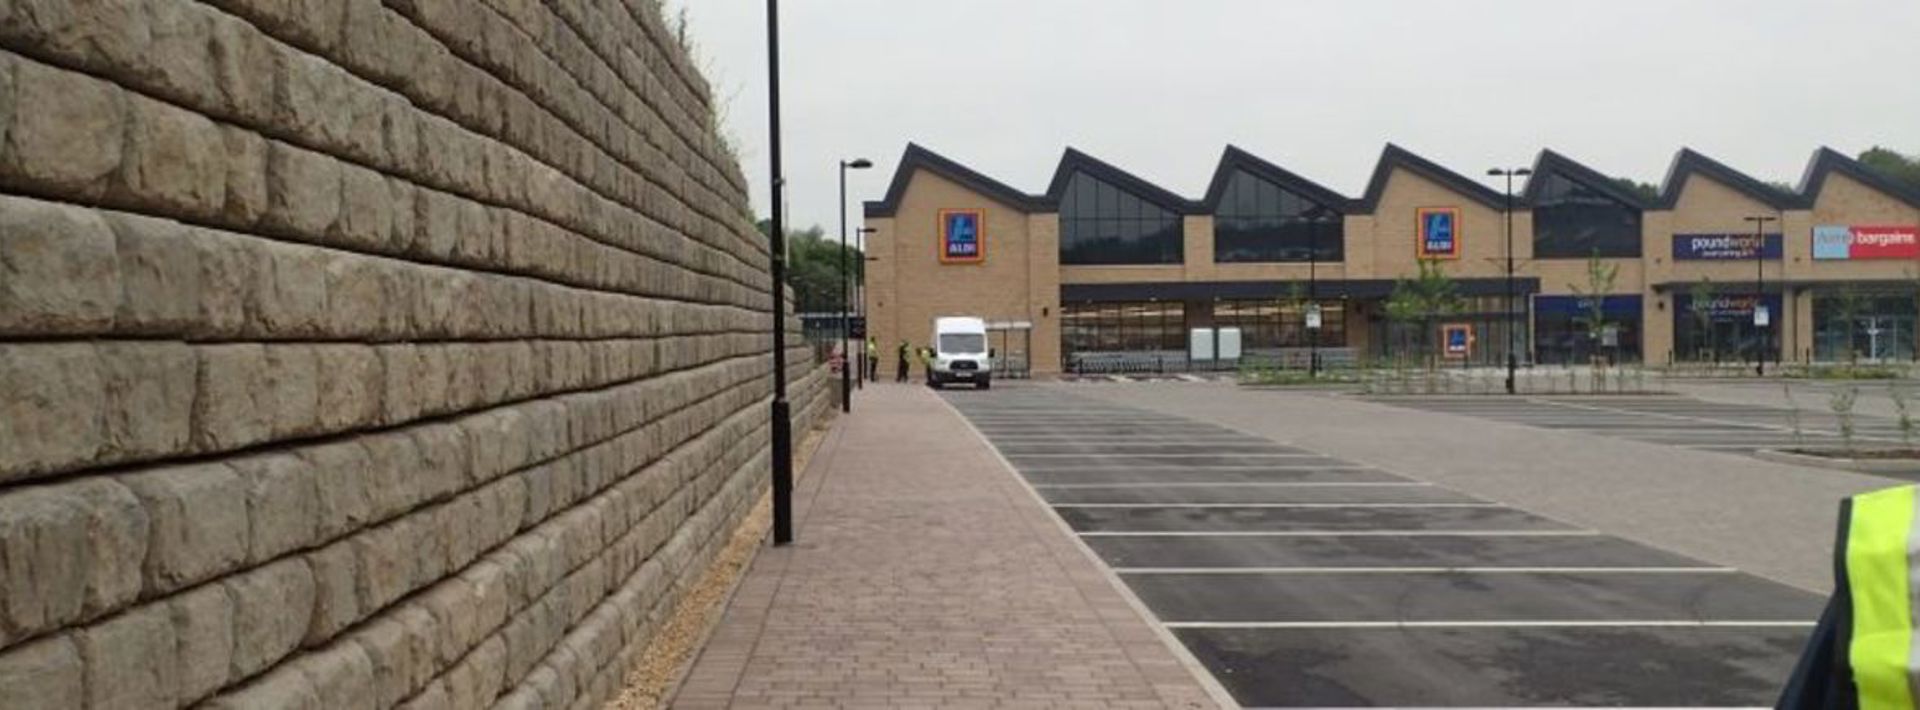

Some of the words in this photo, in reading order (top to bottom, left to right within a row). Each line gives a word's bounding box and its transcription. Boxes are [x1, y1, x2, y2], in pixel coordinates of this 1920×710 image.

[1856, 230, 1915, 247] bargains
[948, 243, 977, 253] ALDI
[1427, 241, 1452, 251] ALDI
